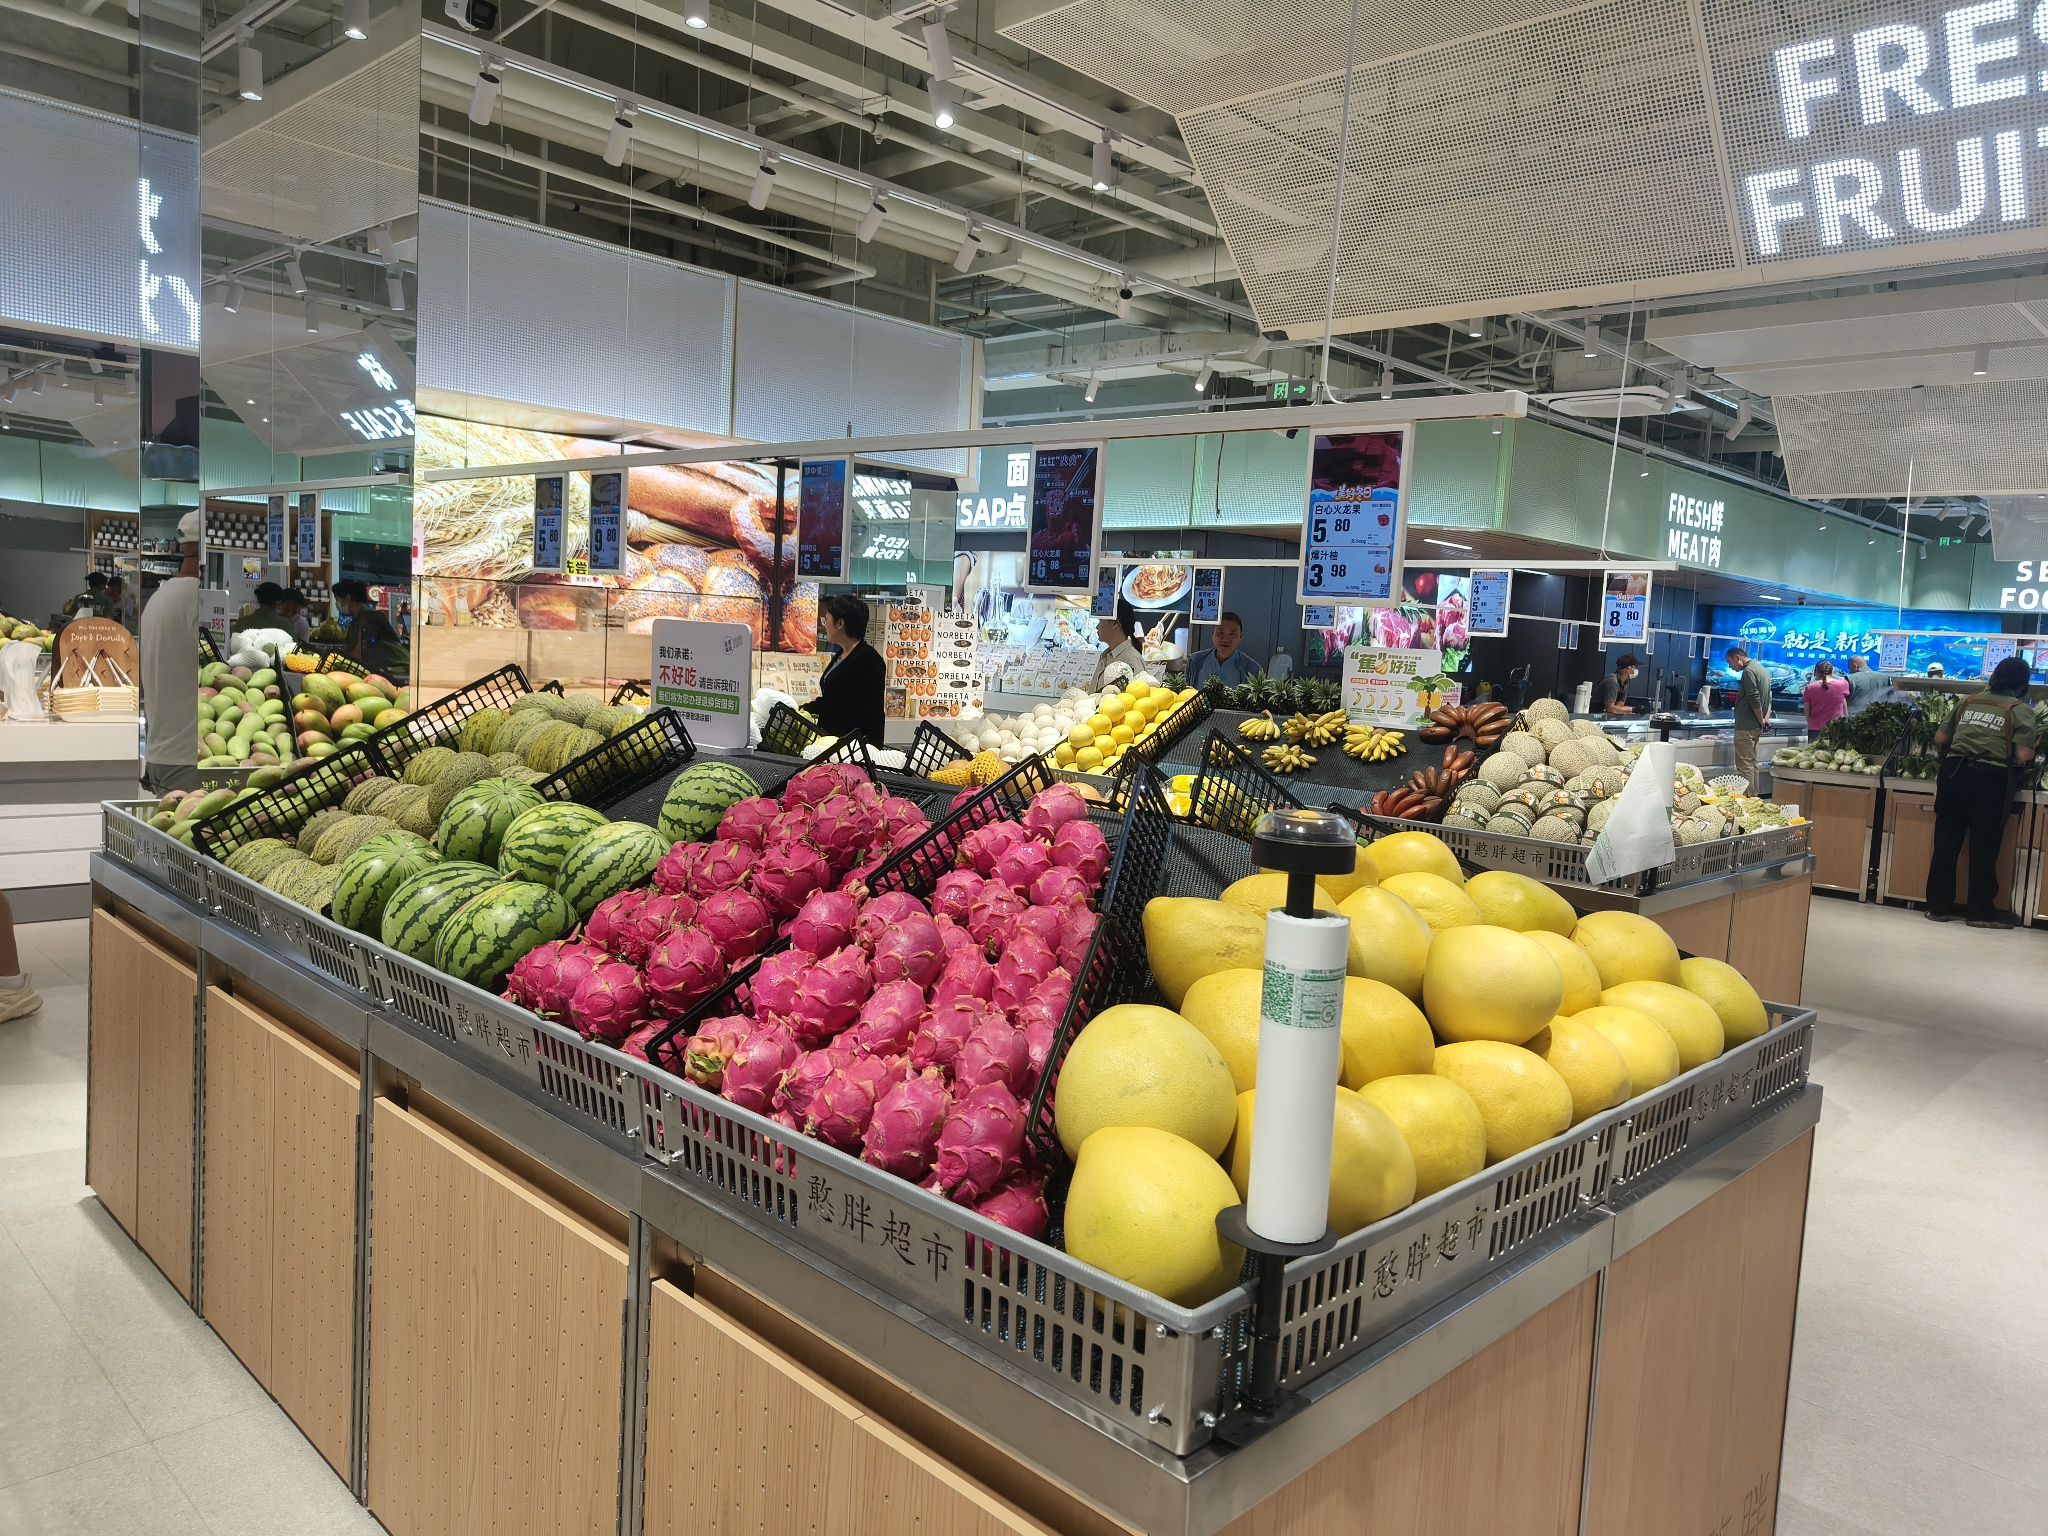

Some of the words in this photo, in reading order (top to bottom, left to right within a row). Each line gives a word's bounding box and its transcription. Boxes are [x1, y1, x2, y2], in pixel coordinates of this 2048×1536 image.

[1775, 0, 2048, 139] FRE
[1746, 127, 2048, 255] FRUI
[1007, 453, 1030, 487] 面
[957, 492, 1027, 526] SAP点
[1315, 504, 1361, 515] 白心火龙果
[938, 611, 976, 620] NORBETA
[938, 631, 974, 640] NORBETA
[1781, 628, 1883, 655] 就是新鲜
[937, 651, 973, 660] NORBETA
[659, 664, 697, 687] 不好吃
[938, 673, 970, 681] ORBETA
[936, 692, 969, 700] ORBETA
[1473, 842, 1545, 867] 憨胖超市
[456, 1003, 530, 1066] 憨胖超市
[808, 1175, 954, 1282] 憨胖超市
[1373, 1206, 1488, 1301] 憨胖超市
